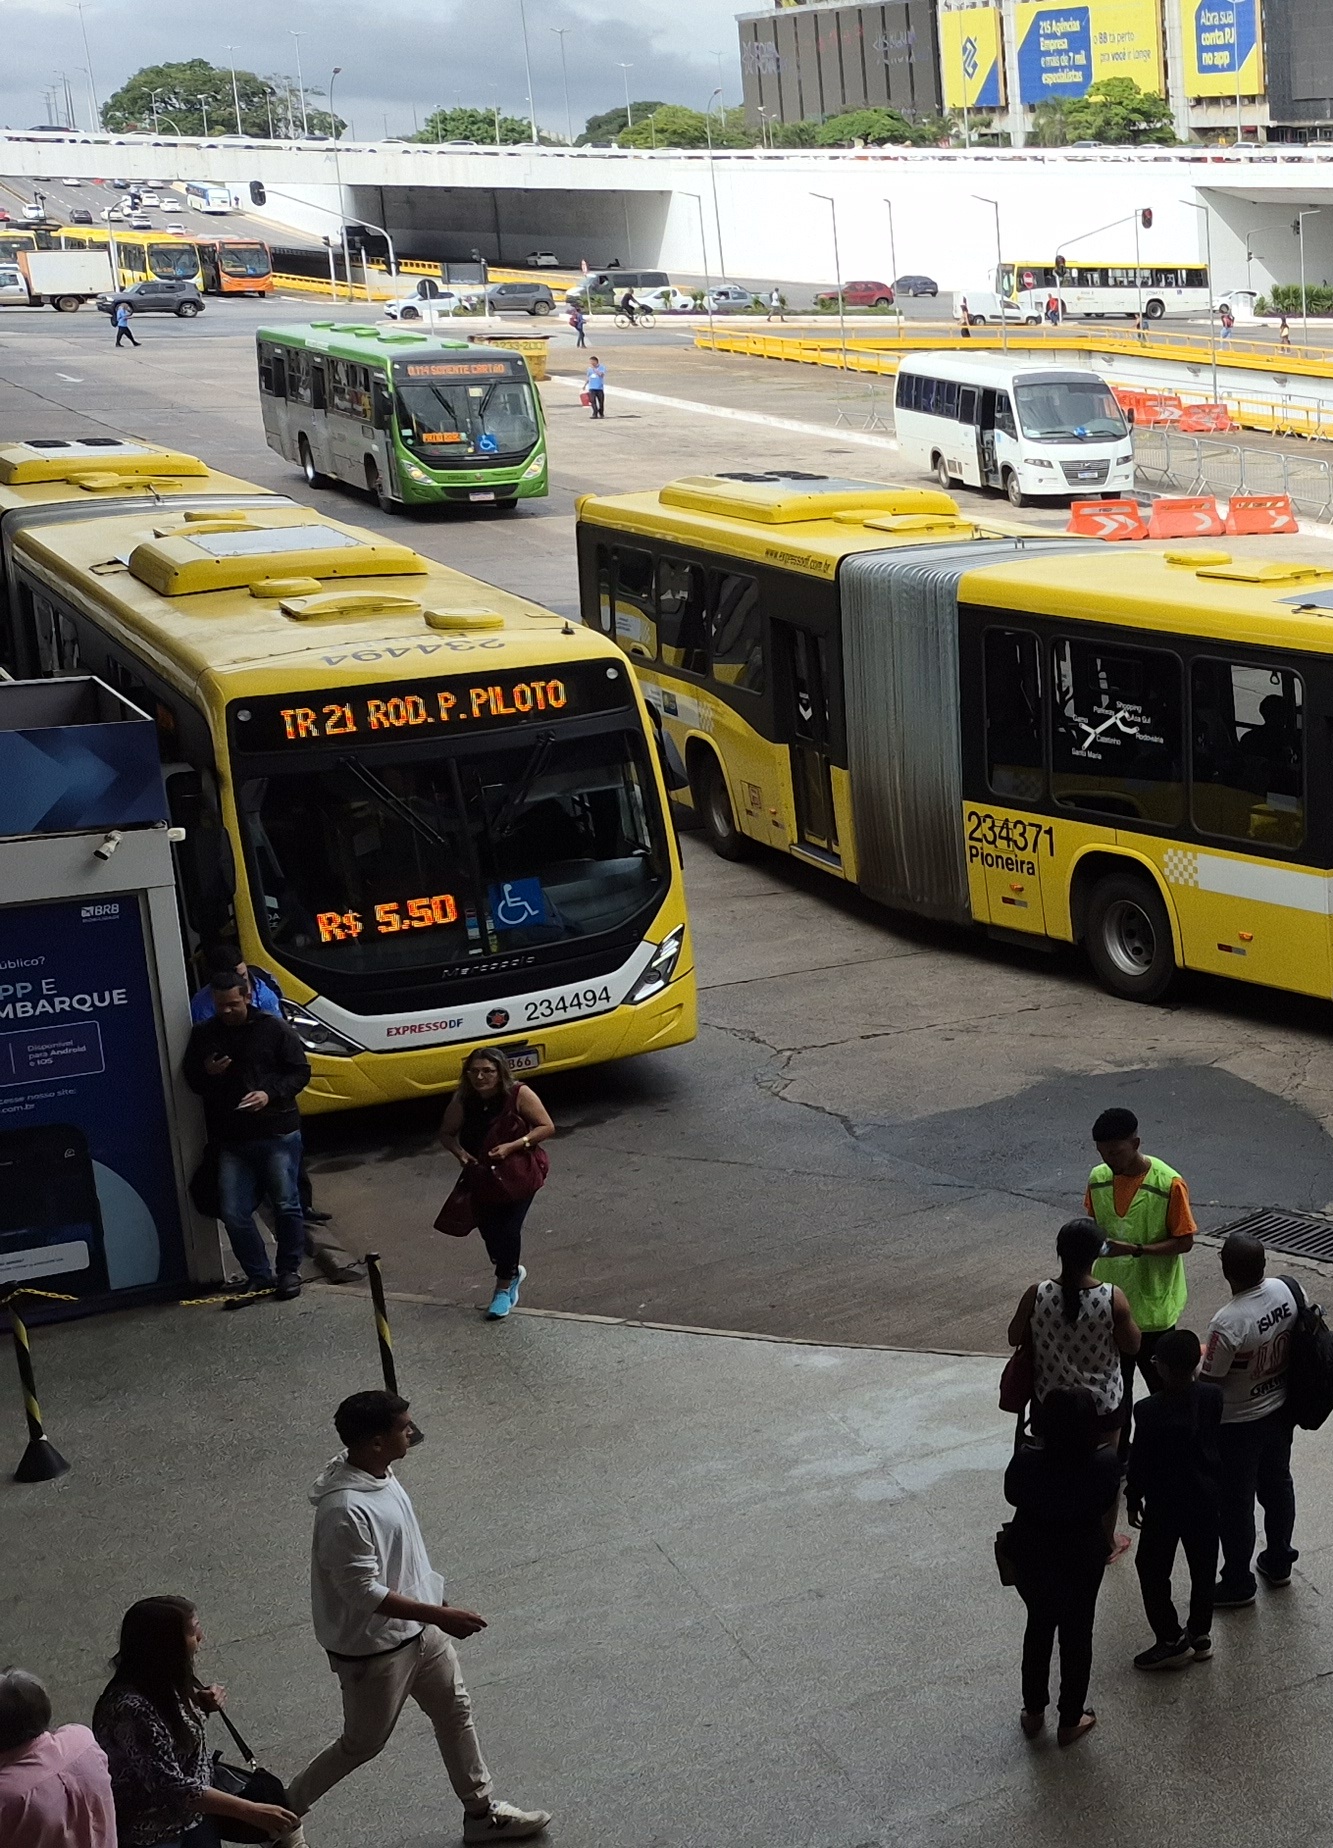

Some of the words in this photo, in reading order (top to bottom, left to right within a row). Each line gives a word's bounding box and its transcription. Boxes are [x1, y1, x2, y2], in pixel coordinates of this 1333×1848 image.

[1201, 9, 1219, 25] Abra
[1220, 11, 1234, 24] sua
[1117, 32, 1135, 46] perto
[1201, 29, 1224, 46] conta
[1225, 27, 1235, 44] PJ
[1202, 51, 1213, 66] no
[1214, 50, 1231, 69] app
[967, 810, 1055, 858] 234371
[969, 845, 1037, 877] Pioneira
[94, 903, 120, 916] BRB
[316, 909, 363, 943] R$
[42, 978, 58, 996] E
[524, 985, 613, 1022] 234494
[386, 1018, 464, 1038] EXPRESSODF
[50, 1045, 87, 1057] Android
